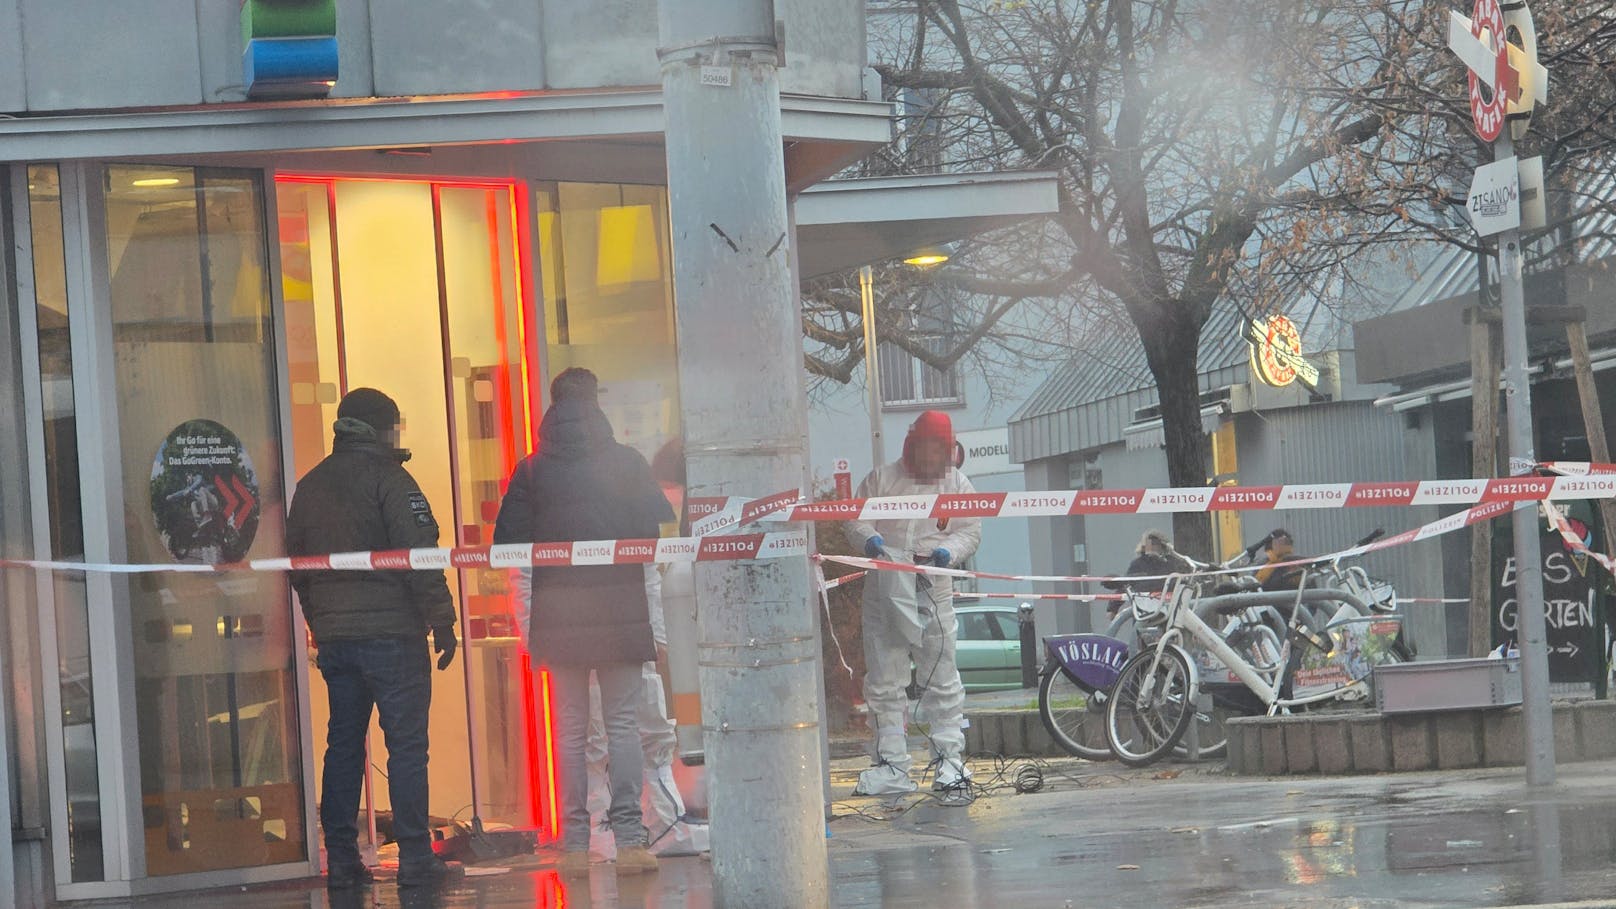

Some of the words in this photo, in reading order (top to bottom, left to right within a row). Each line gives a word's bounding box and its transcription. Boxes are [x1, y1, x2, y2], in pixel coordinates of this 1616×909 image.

[1472, 0, 1506, 53] TABAK
[1471, 80, 1507, 134] TRAFIK
[176, 436, 186, 445] Ihr
[187, 435, 196, 445] Go
[207, 435, 221, 445] eine
[168, 457, 182, 465] Das
[1432, 486, 1478, 496] POLIZEI
[1500, 483, 1546, 494] POLIZEI
[1566, 481, 1614, 491] POLIZEI
[1226, 493, 1273, 502] POLIZEI
[1295, 490, 1342, 500] POLIZEI
[1363, 488, 1410, 498] POLIZEI
[1018, 498, 1066, 508] POLIZEI
[1087, 496, 1135, 506] POLIZEI
[1157, 494, 1204, 504] POLIZEI
[808, 503, 857, 513] POLIZEI
[878, 501, 927, 511] POLIZEI
[948, 500, 997, 510] POLIZEI
[1470, 501, 1504, 520] POLIZEI
[623, 545, 653, 556] POLIZEI
[665, 543, 695, 553] POLIZEI
[708, 541, 754, 552] POLIZEI
[499, 550, 528, 560] POLIZEI
[540, 549, 569, 560] POLIZEI
[581, 547, 611, 557] POLIZEI
[458, 552, 487, 563] POLIZEI
[1501, 552, 1571, 587] ES
[1500, 588, 1595, 631] GRTEN
